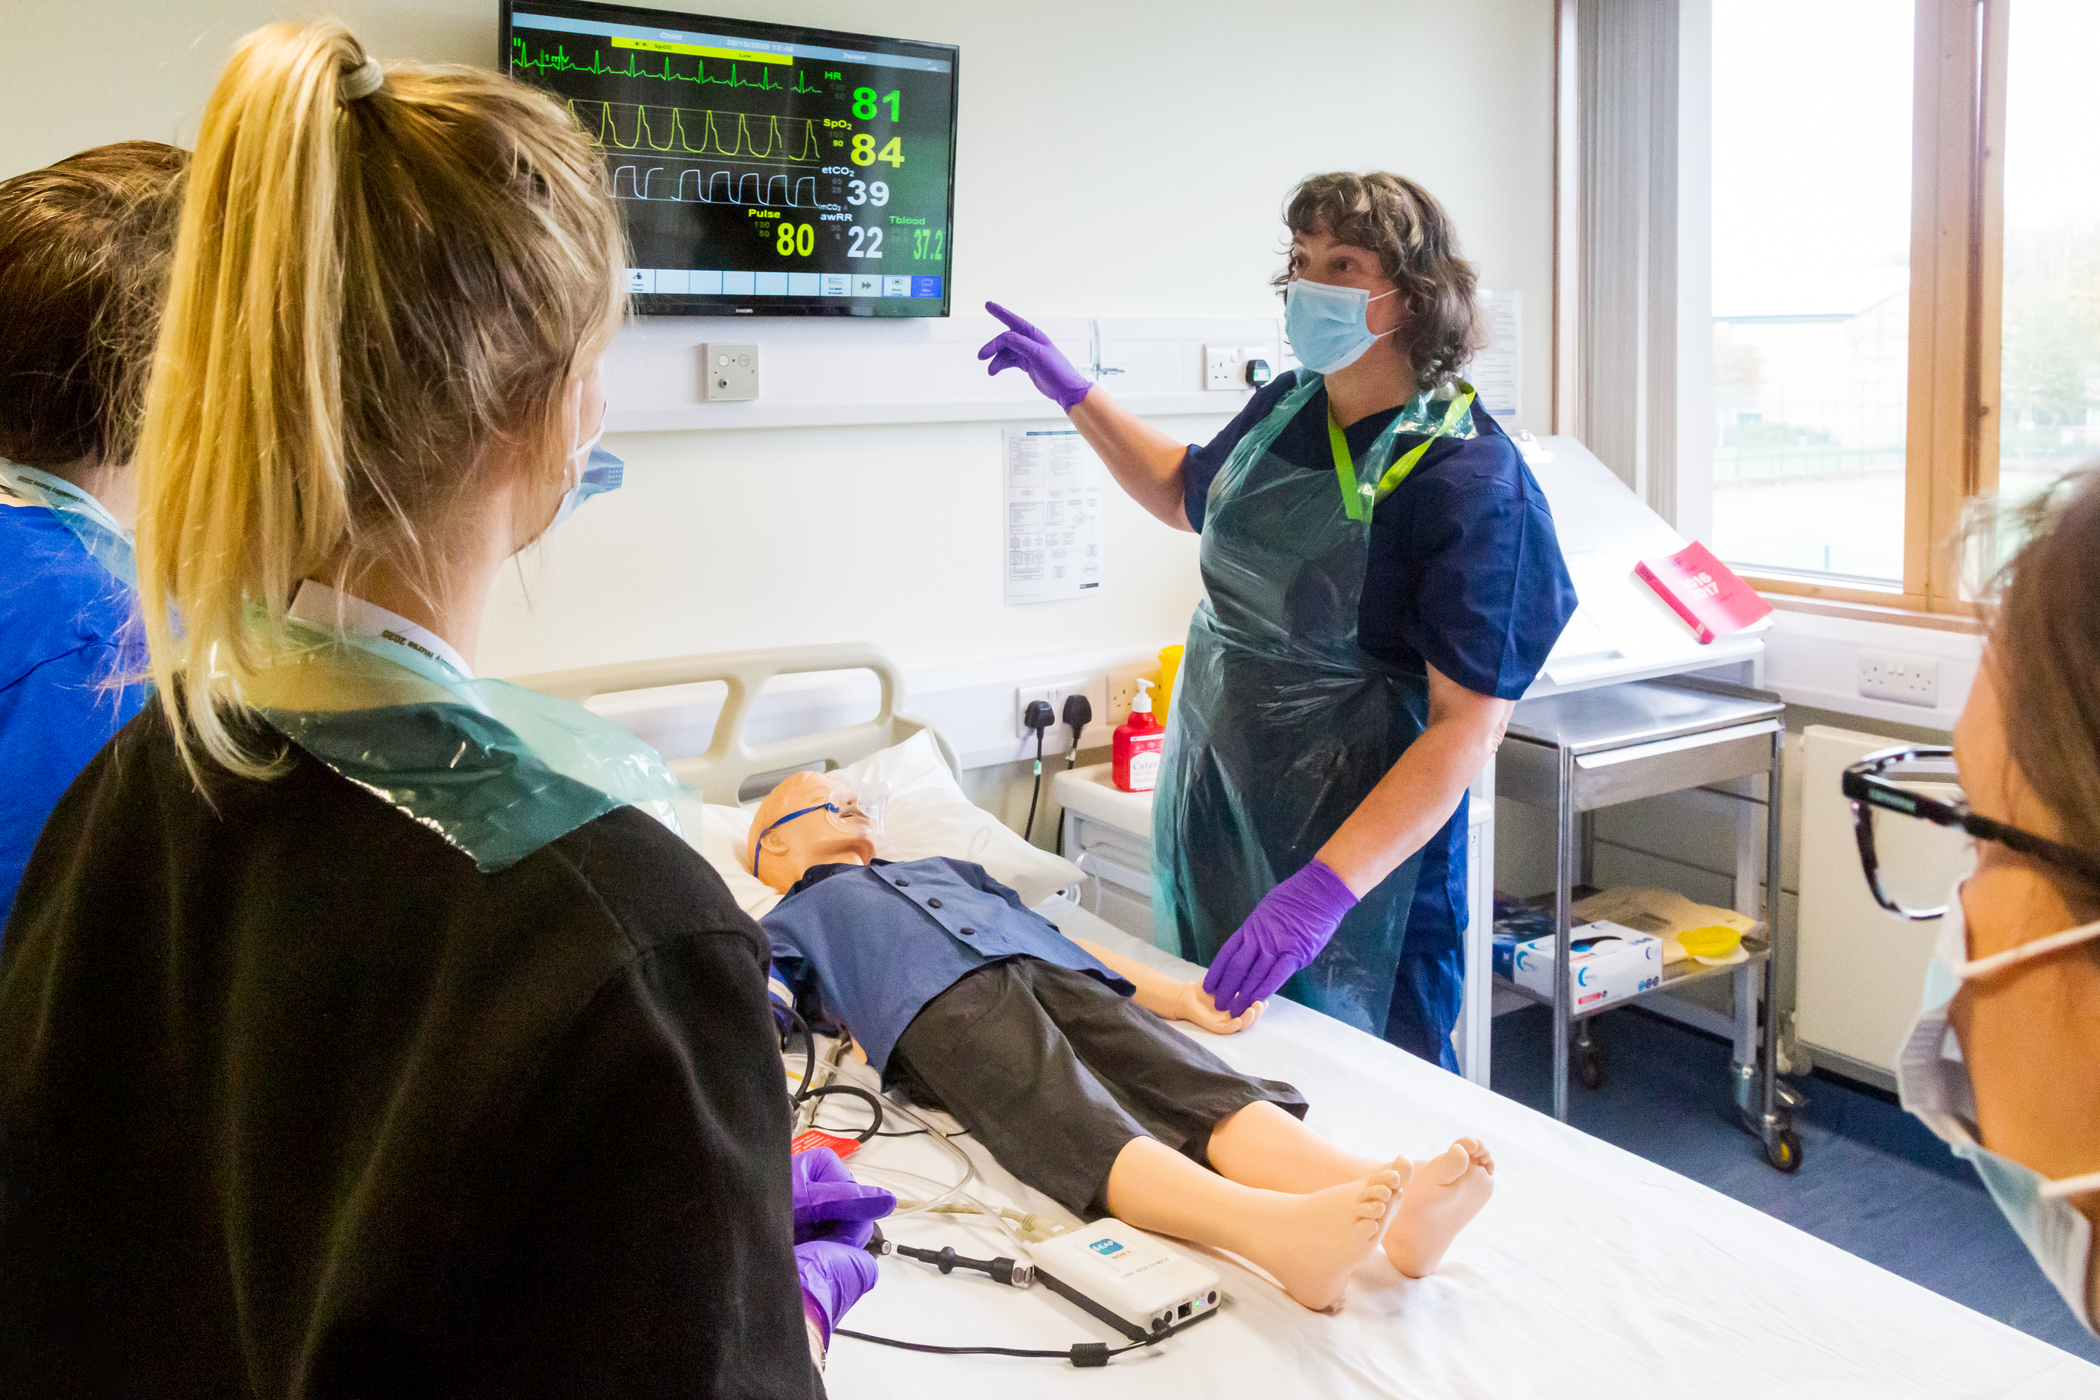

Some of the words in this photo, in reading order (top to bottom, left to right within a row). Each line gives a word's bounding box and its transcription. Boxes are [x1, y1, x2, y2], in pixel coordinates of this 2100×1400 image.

[659, 31, 682, 41] Child
[654, 43, 672, 51] SpO2
[824, 71, 842, 81] HR
[851, 86, 900, 122] 81
[823, 118, 852, 131] SpO2
[850, 133, 905, 168] 84
[821, 166, 855, 178] etCO2
[846, 179, 890, 207] 39
[748, 209, 781, 219] Pulse
[820, 213, 853, 222] awRR
[889, 216, 926, 226] Tblood
[776, 222, 815, 256] 80
[847, 226, 883, 258] 22
[913, 228, 944, 260] 37.2
[1679, 572, 1712, 590] 2016
[1689, 581, 1719, 599] 2017
[382, 630, 407, 645] 2020
[407, 641, 434, 659] Nurse
[1136, 1266, 1148, 1274] BOX
